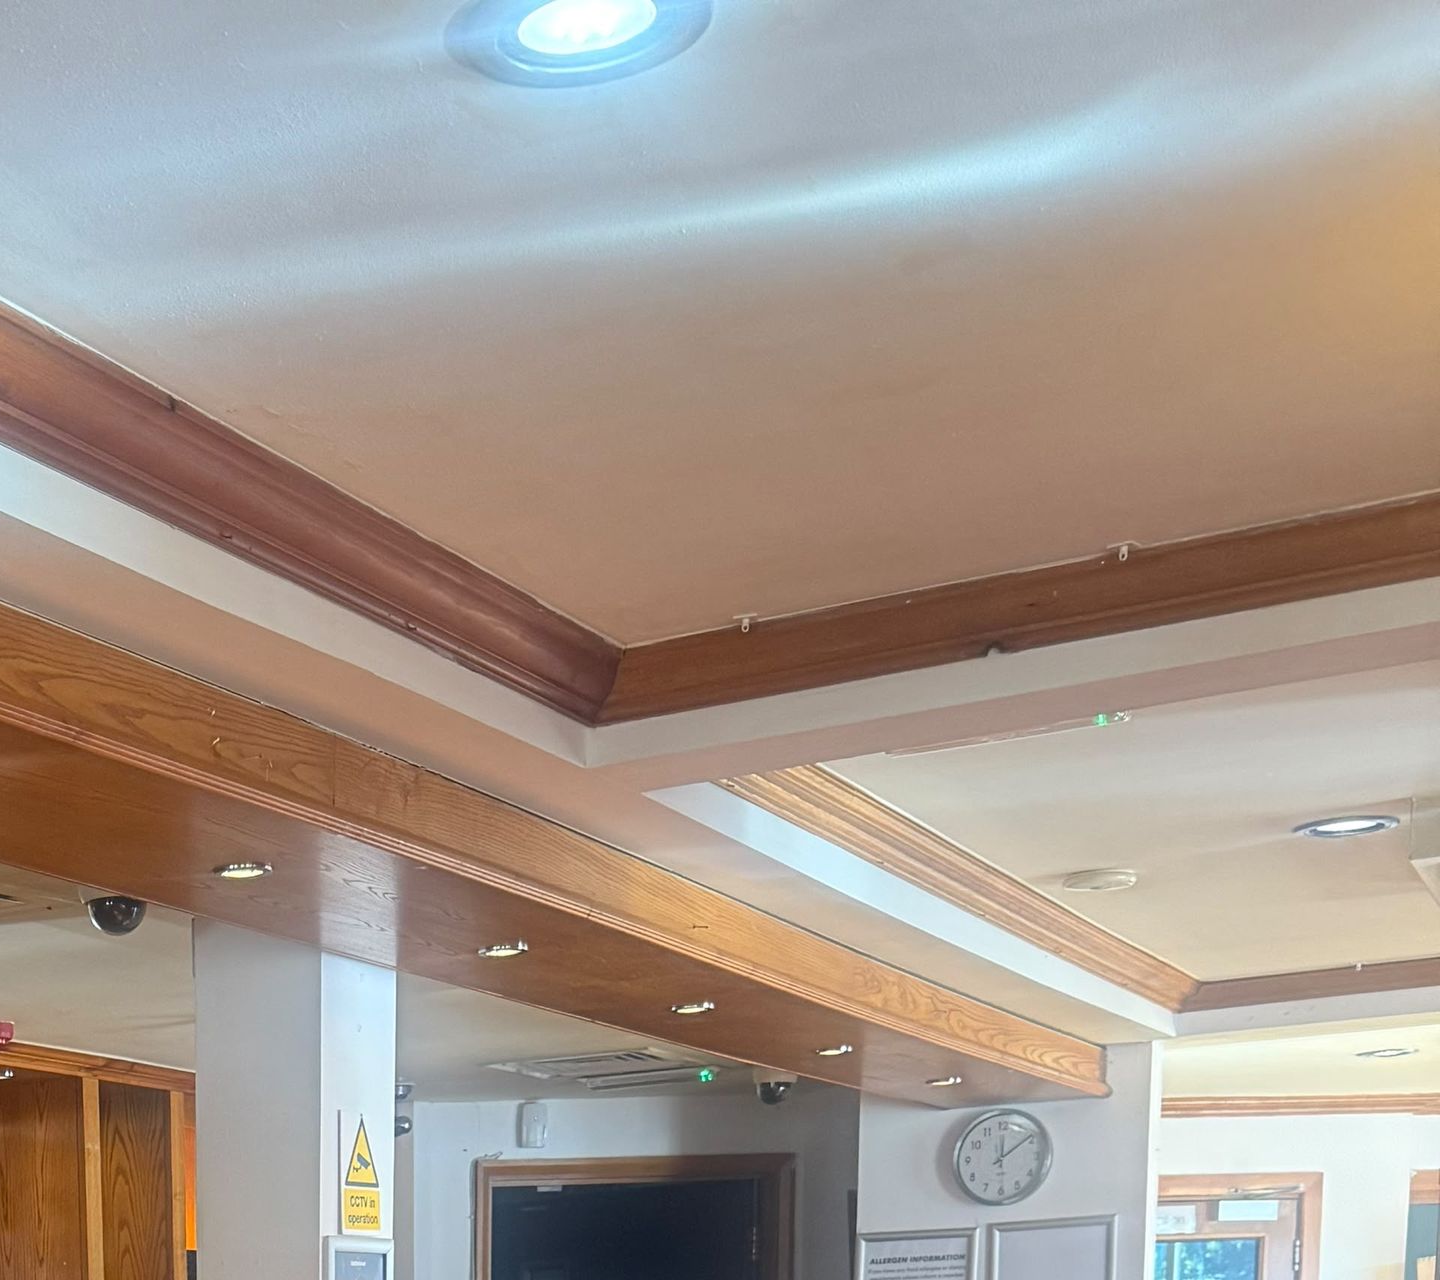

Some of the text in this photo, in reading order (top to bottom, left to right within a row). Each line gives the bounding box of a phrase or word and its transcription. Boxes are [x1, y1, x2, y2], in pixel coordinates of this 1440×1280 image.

[998, 1121, 1009, 1130] 12
[983, 1127, 992, 1136] 11
[971, 1140, 982, 1150] 10
[964, 1155, 972, 1166] 9
[969, 1172, 976, 1182] 8
[983, 1182, 989, 1193] 7
[997, 1185, 1005, 1196] 6
[350, 1196, 376, 1208] CCTV in
[348, 1214, 378, 1227] operation
[870, 1254, 966, 1265] ALLERGEN INFORMATION
